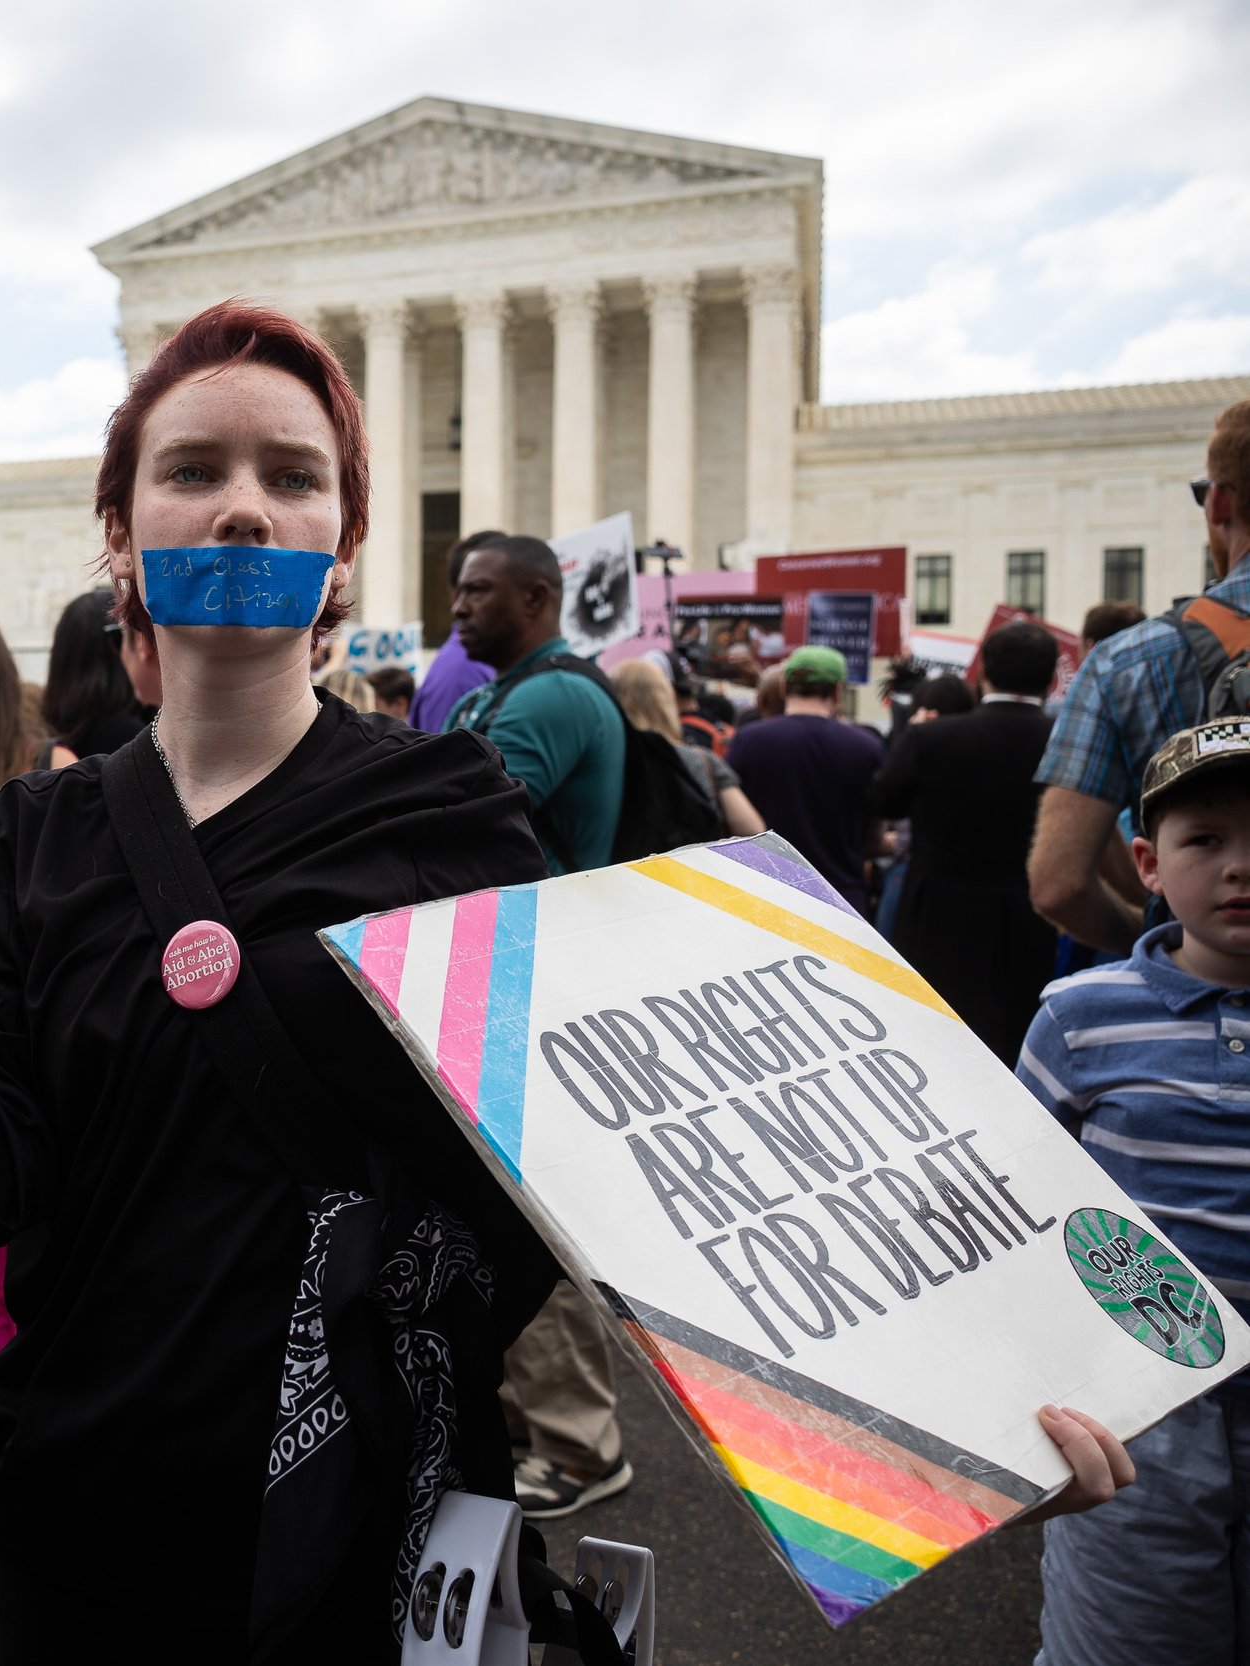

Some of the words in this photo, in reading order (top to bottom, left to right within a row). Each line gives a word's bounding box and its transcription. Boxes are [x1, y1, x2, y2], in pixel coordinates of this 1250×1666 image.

[161, 556, 194, 577] 2nd
[213, 556, 271, 577] Class
[204, 584, 300, 611] Citizen
[163, 957, 185, 976] Aid
[187, 955, 196, 965] &
[197, 942, 230, 962] Abet
[169, 947, 182, 958] ask
[193, 938, 209, 948] how
[209, 934, 217, 942] to
[166, 956, 234, 991] Abortion
[539, 1008, 708, 1130] OUR
[640, 954, 888, 1092] RIGHTS
[624, 1104, 794, 1240] ARE
[726, 1068, 889, 1193] NOT
[840, 1047, 949, 1144] UP
[696, 1212, 888, 1359] FOR
[816, 1129, 1058, 1301] DEBATE
[1087, 1235, 1144, 1275] OUR
[1108, 1259, 1165, 1299] RIGHTS
[1129, 1281, 1204, 1348] DC
